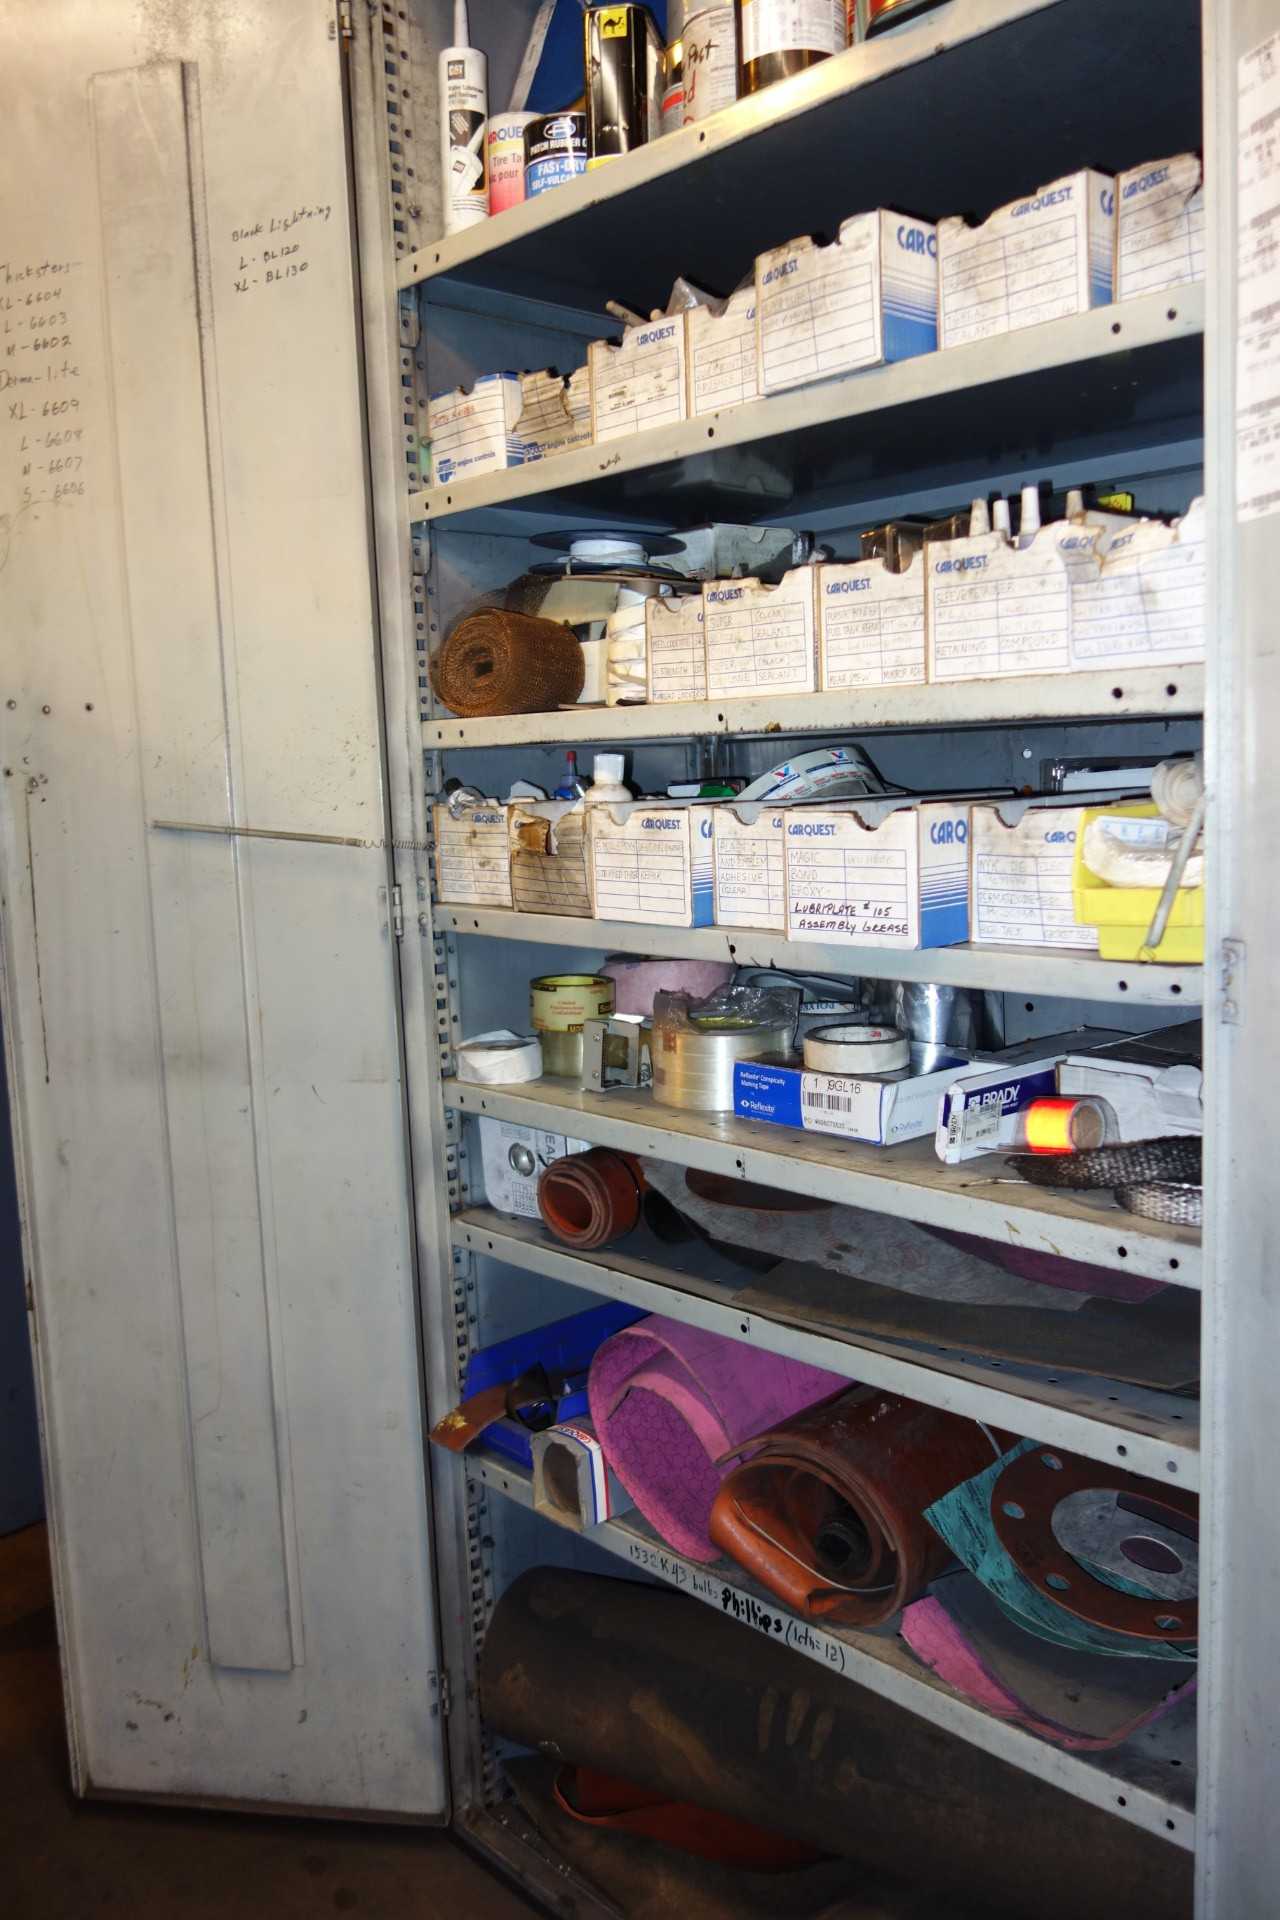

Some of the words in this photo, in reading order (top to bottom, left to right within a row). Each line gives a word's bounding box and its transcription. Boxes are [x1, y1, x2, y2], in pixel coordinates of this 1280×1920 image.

[1123, 166, 1171, 199] CARQUEST
[1011, 186, 1073, 218] CARQUEST
[762, 258, 799, 286] CARQUEST
[935, 554, 989, 574] CARQUEST
[706, 587, 745, 602] CARQUEST
[826, 577, 872, 595] CARQUEST
[641, 818, 681, 831] CARQUEST
[788, 823, 837, 837] CARQUEST
[794, 902, 857, 917] LUBRIPLATE
[862, 921, 909, 935] GREASE
[982, 1084, 1021, 1106] BRADY
